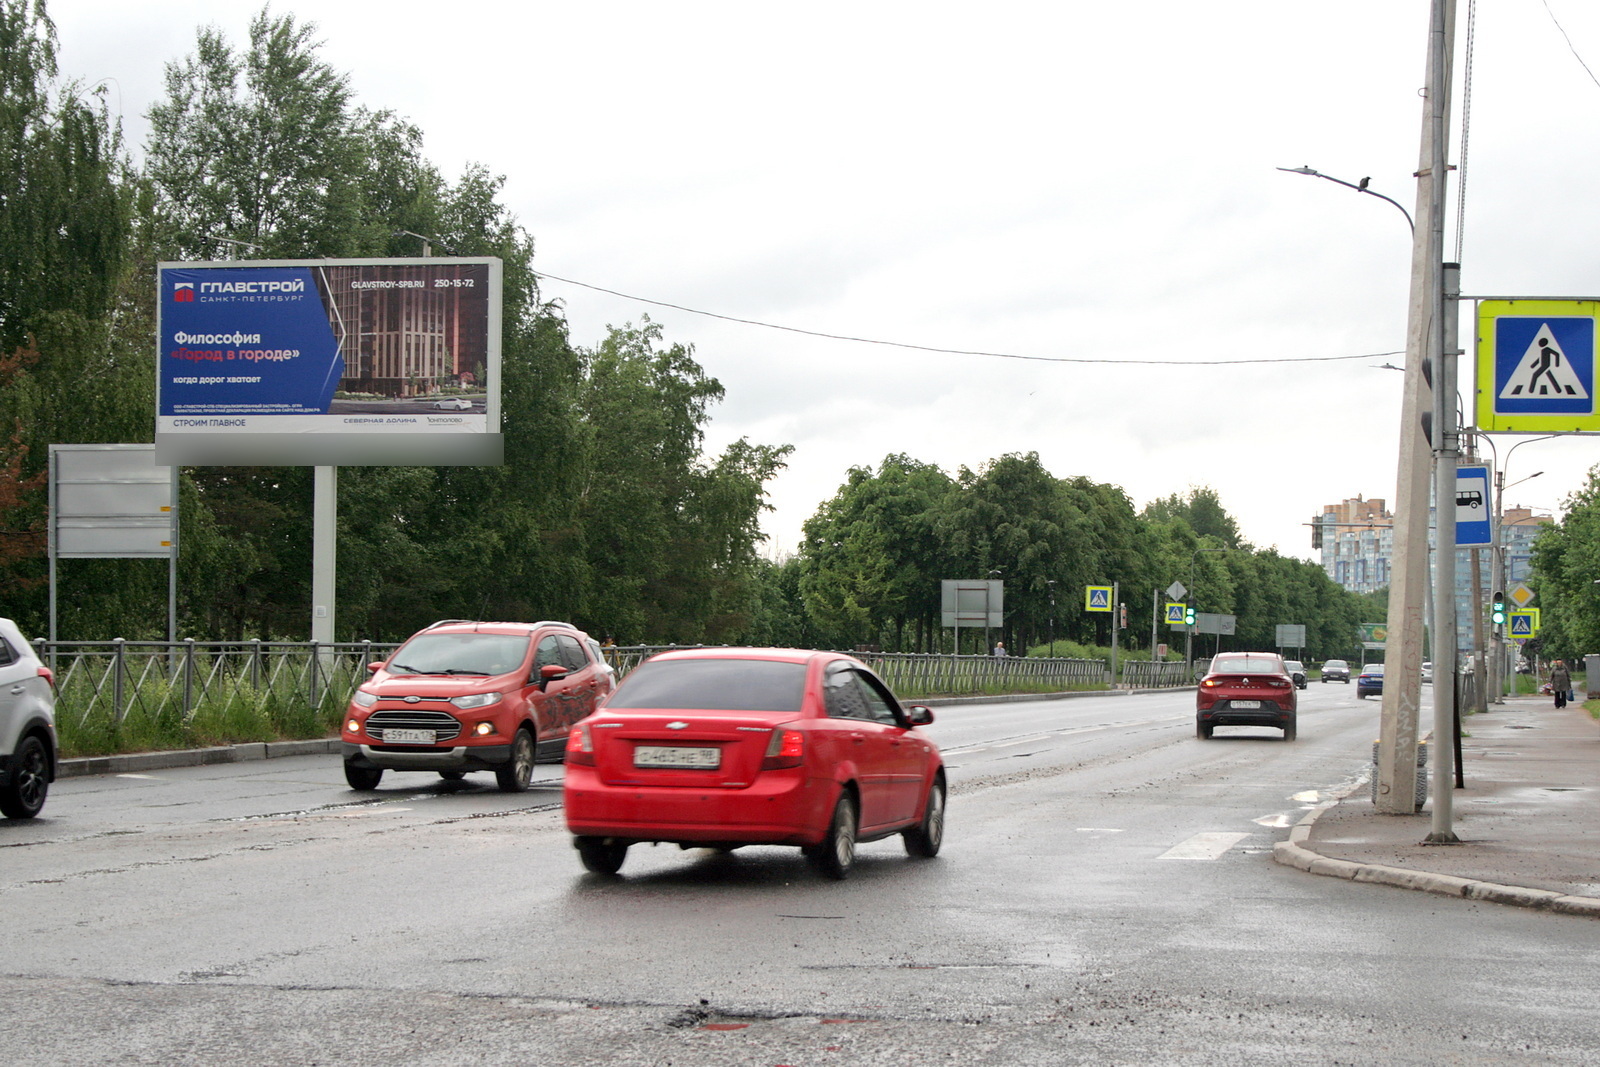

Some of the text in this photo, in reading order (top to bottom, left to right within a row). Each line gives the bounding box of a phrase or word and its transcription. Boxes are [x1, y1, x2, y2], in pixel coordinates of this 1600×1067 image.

[200, 278, 305, 293] ГЛАВСТРОЙ
[351, 280, 425, 289] GLAVSTROY-SPB.RU
[200, 295, 304, 303] САНКТ-ПЕТЕРБУРГ
[174, 330, 261, 347] Философия
[171, 347, 300, 363] «Город в городе»
[173, 376, 198, 385] когда
[199, 376, 225, 385] дорог
[173, 419, 246, 427] СТРОИМ ГЛАВНОЕ
